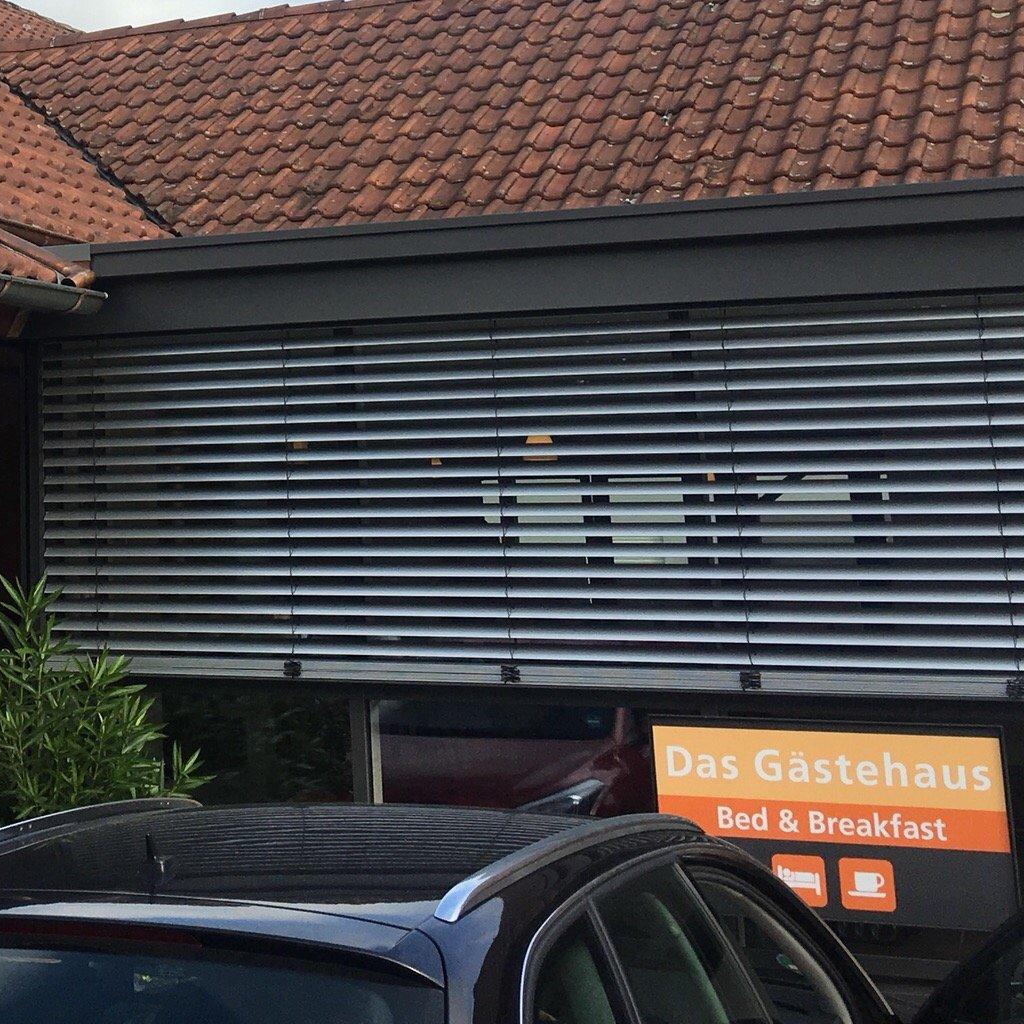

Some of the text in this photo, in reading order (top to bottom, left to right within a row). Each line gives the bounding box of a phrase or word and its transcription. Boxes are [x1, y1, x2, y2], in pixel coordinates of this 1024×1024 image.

[665, 745, 993, 791] Das Gästehaus
[717, 806, 948, 842] Bed & Breakfast
